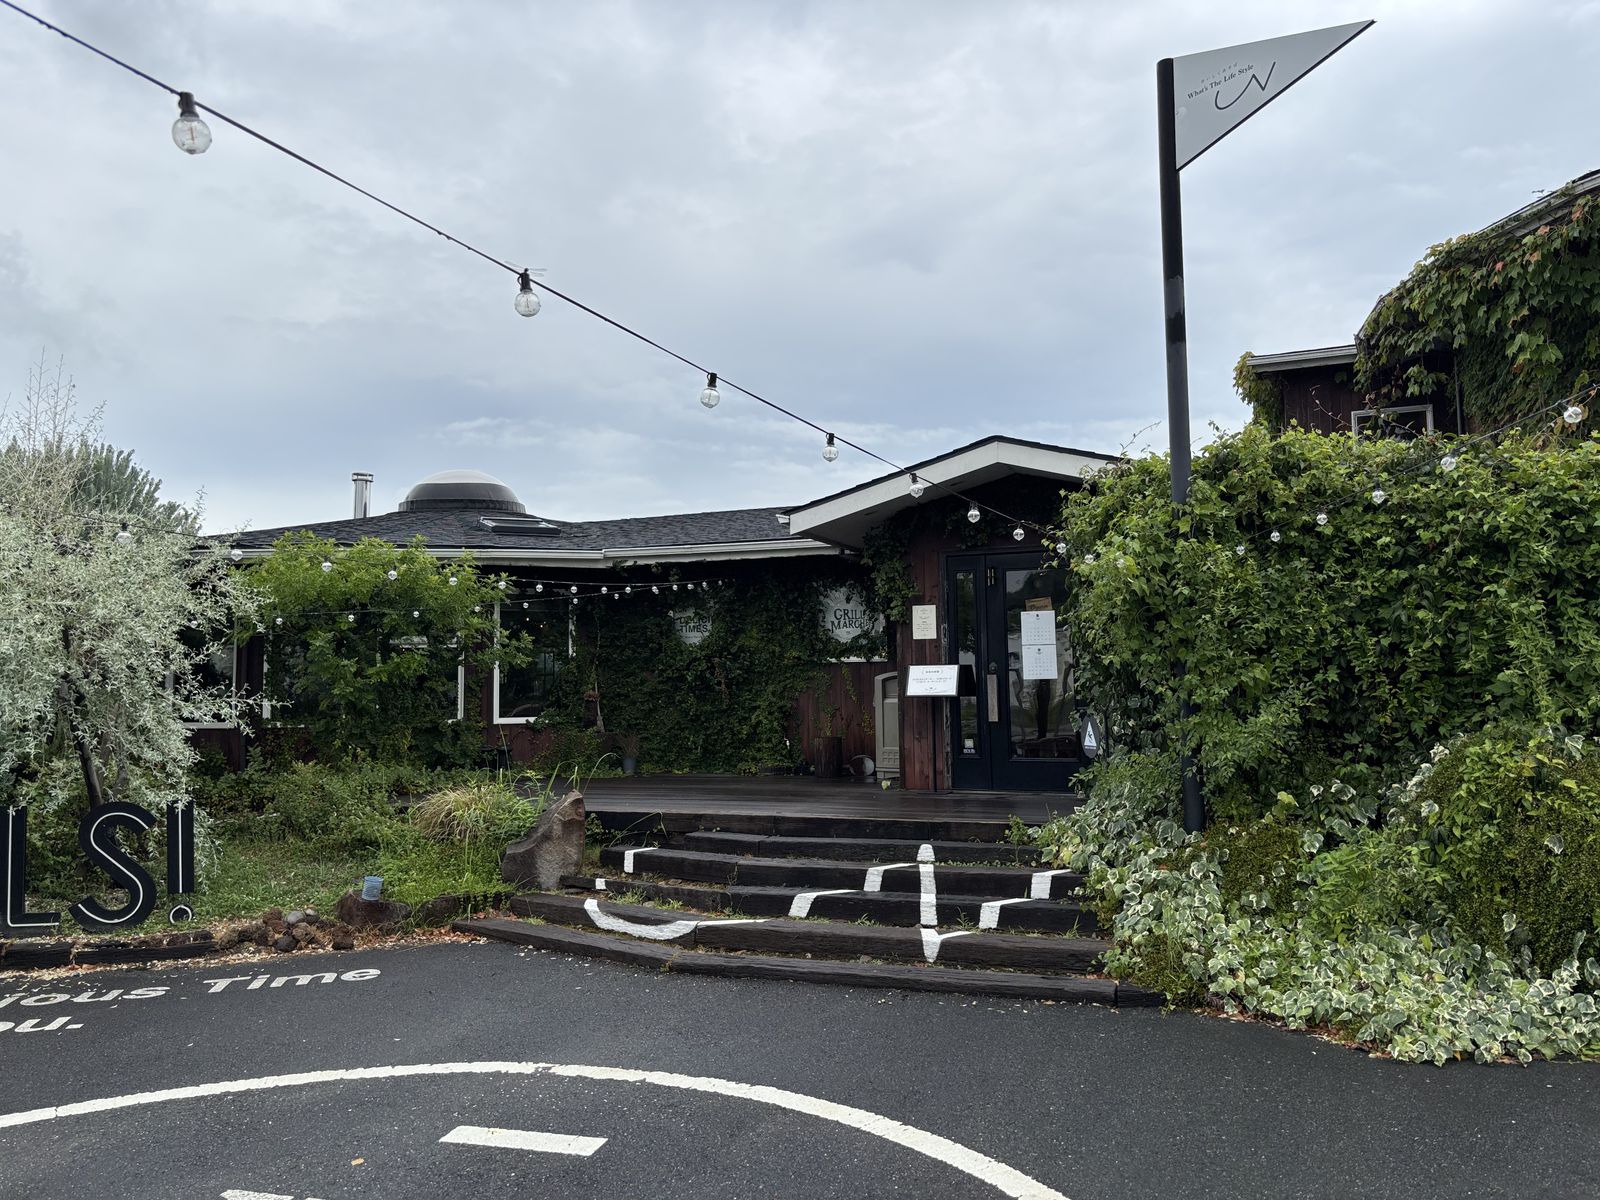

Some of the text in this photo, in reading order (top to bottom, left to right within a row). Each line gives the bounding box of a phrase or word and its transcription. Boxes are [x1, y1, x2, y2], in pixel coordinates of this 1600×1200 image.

[1187, 85, 1208, 100] What's
[1209, 79, 1222, 89] The
[1223, 72, 1237, 82] Life
[1237, 64, 1254, 76] Style
[680, 624, 708, 633] TIMES
[203, 968, 381, 993] Time
